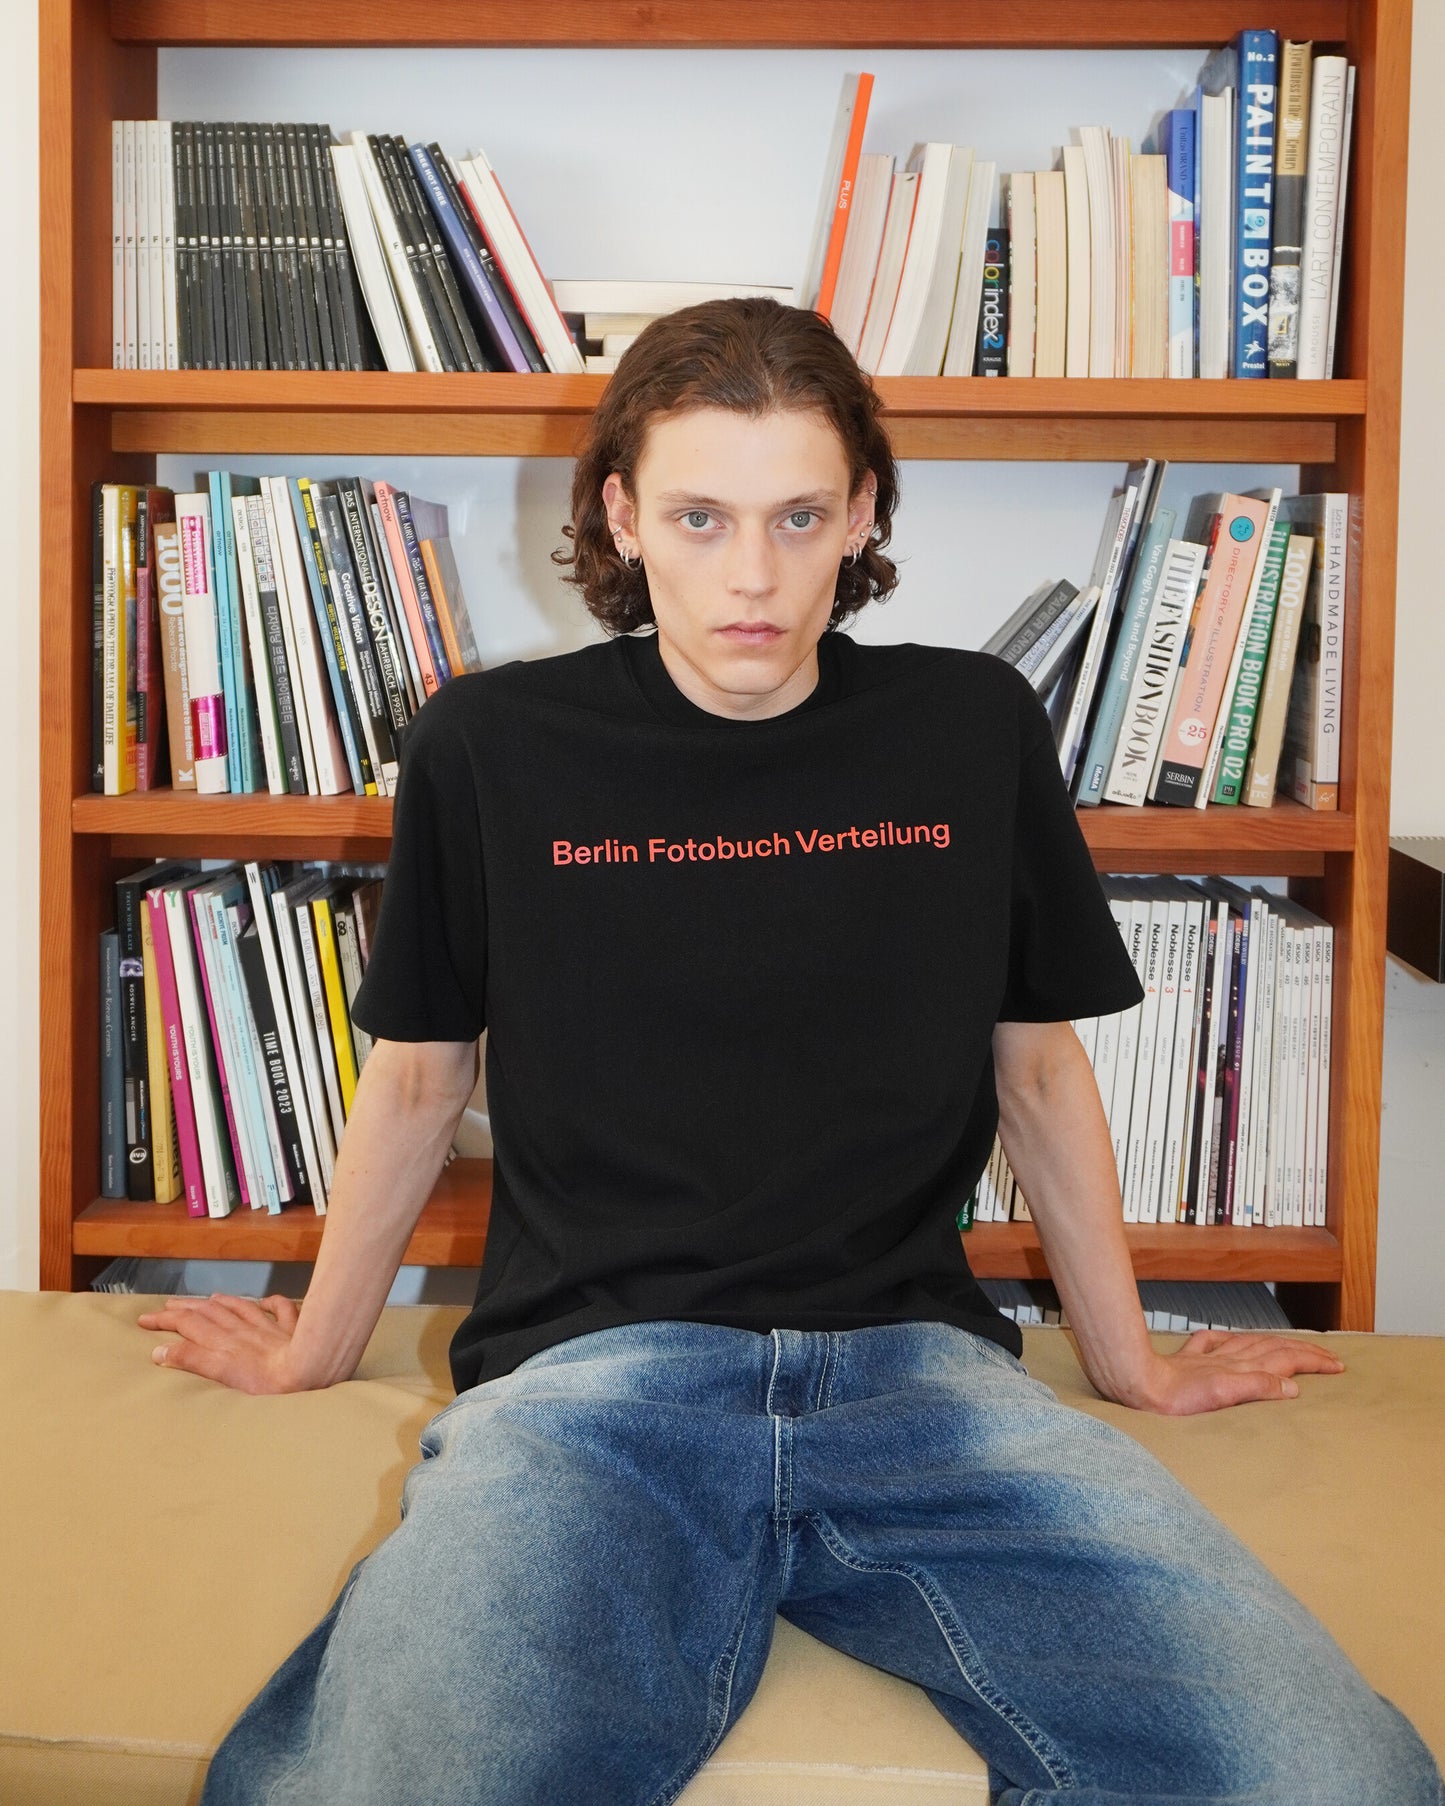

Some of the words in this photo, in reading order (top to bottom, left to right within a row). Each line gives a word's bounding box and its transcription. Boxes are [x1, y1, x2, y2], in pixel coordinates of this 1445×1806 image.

[1288, 48, 1305, 93] Eyewitness
[1287, 103, 1303, 117] the
[1288, 94, 1303, 102] to
[1244, 83, 1273, 203] PAINT
[1283, 138, 1301, 170] Century
[414, 147, 428, 167] FREE
[1313, 74, 1341, 240] CONTEMPORAIN
[837, 179, 851, 209] PLUS
[1241, 248, 1269, 326] BOX
[1309, 247, 1330, 300] L'ART
[1242, 361, 1265, 369] Prestel
[344, 490, 355, 508] DAS
[377, 487, 392, 522] artnow
[236, 509, 244, 530] DESIGN
[1334, 509, 1342, 538] Lotta
[302, 536, 312, 562] artnow
[349, 510, 372, 582] INTERNATIONALE
[1150, 542, 1163, 564] Van
[156, 533, 182, 615] 1000
[1139, 563, 1157, 595] Gogh,
[1218, 546, 1240, 614] DIRECTORY
[1277, 546, 1308, 609] 1000
[106, 567, 115, 638] PHOTOGRAPHING
[340, 571, 358, 614] Creative
[350, 614, 364, 644] Vision
[361, 581, 388, 642] DESIGN
[1031, 590, 1068, 630] PAPER
[1326, 545, 1340, 658] HANDMADE
[167, 616, 176, 645] Rebecca
[265, 605, 281, 644] 디자이닝
[1216, 615, 1223, 625] OF
[1285, 609, 1295, 625] new
[1129, 621, 1142, 641] and
[1283, 626, 1292, 638] eco
[106, 640, 114, 655] THE
[169, 646, 177, 672] Proctor
[271, 645, 286, 674] 브랜드
[105, 657, 114, 689] DRAMA
[378, 641, 396, 688] JAHRBUCH
[1117, 642, 1137, 681] Beyond
[1193, 627, 1220, 713] ILLUSTRATION
[177, 647, 186, 675] designs
[183, 716, 190, 724] to
[423, 672, 433, 686] 43
[1233, 658, 1263, 710] BOOK
[105, 690, 114, 701] OF
[275, 675, 293, 724] 아이덴티티
[1323, 668, 1336, 734] LIVING
[105, 702, 114, 725] DAILY
[390, 692, 405, 727] 1993/94
[105, 727, 113, 744] LIFE
[1187, 725, 1207, 740] 25
[1226, 712, 1252, 752] PRO
[1090, 765, 1102, 789] MoMA
[1166, 771, 1195, 784] SERBIN
[1221, 754, 1244, 780] 02
[552, 840, 638, 866] Berlin
[648, 833, 791, 863] Fotobuch
[795, 821, 951, 854] Verteilung
[148, 891, 161, 909] Y
[166, 892, 179, 907] Y
[216, 909, 225, 930] ARCHIVE
[336, 920, 346, 935] GQ
[219, 930, 227, 945] PRISM
[1147, 923, 1161, 980] Noblesse
[1165, 923, 1178, 981] Noblesse
[1183, 924, 1196, 981] Noblesse
[1146, 985, 1156, 993] 4
[104, 997, 112, 1022] Korean
[168, 1024, 178, 1047] YOUTH
[187, 1024, 197, 1049] YOUTH
[262, 1030, 279, 1055] TIME
[172, 1055, 182, 1080] YOURS
[191, 1055, 201, 1080] YOURS
[268, 1058, 286, 1085] BOOK
[1234, 1062, 1239, 1070] 01
[274, 1088, 292, 1115] 2023
[191, 1200, 198, 1208] 11
